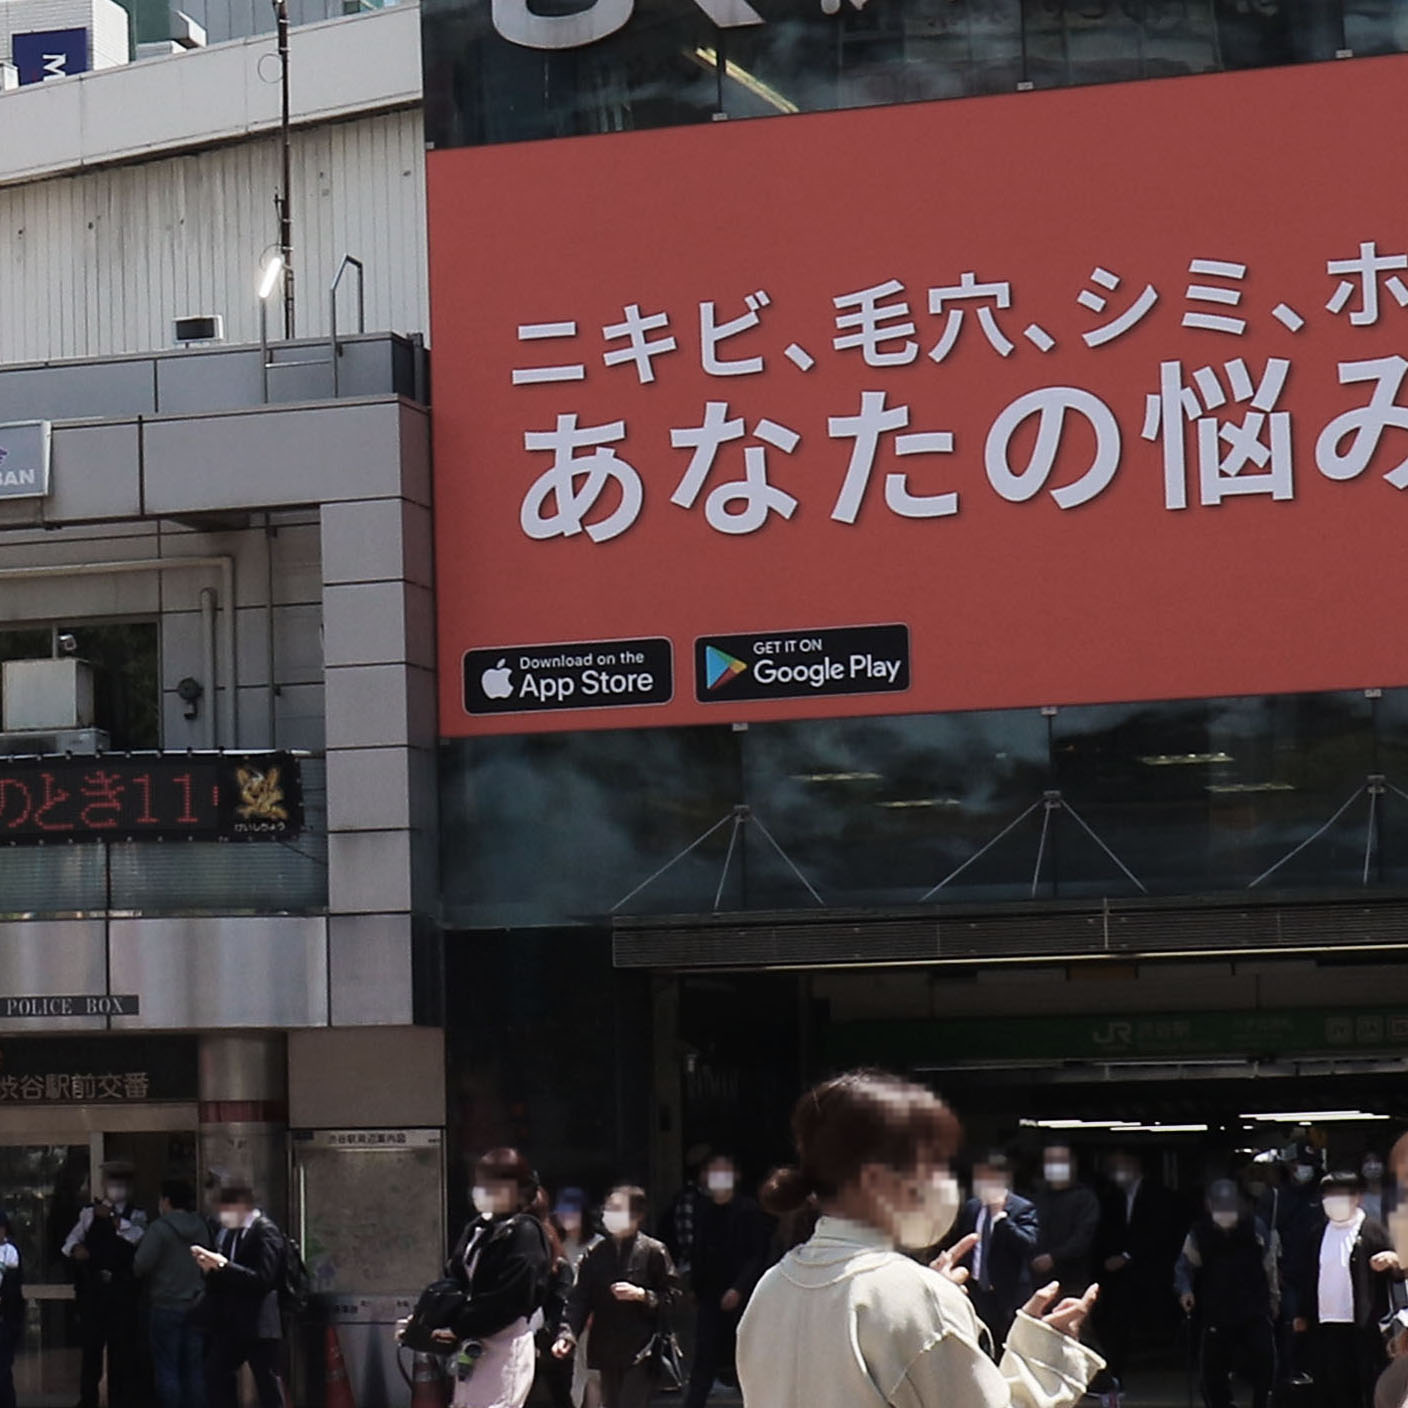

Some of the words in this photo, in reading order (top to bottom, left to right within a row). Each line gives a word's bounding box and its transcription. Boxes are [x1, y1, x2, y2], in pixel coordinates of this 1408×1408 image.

[511, 241, 1408, 385] ニキビ、毛穴、シミ、ホ
[520, 355, 1408, 543] あなたの悩み
[520, 653, 593, 670] Download
[596, 655, 616, 666] on
[620, 650, 645, 665] the
[753, 640, 782, 654] GET
[785, 639, 798, 653] IT
[800, 638, 823, 652] ON
[519, 673, 578, 701] App
[581, 668, 654, 695] Store
[753, 658, 844, 688] Google
[850, 653, 902, 683] Play
[6, 998, 72, 1015] POLICE
[86, 997, 124, 1014] BOX
